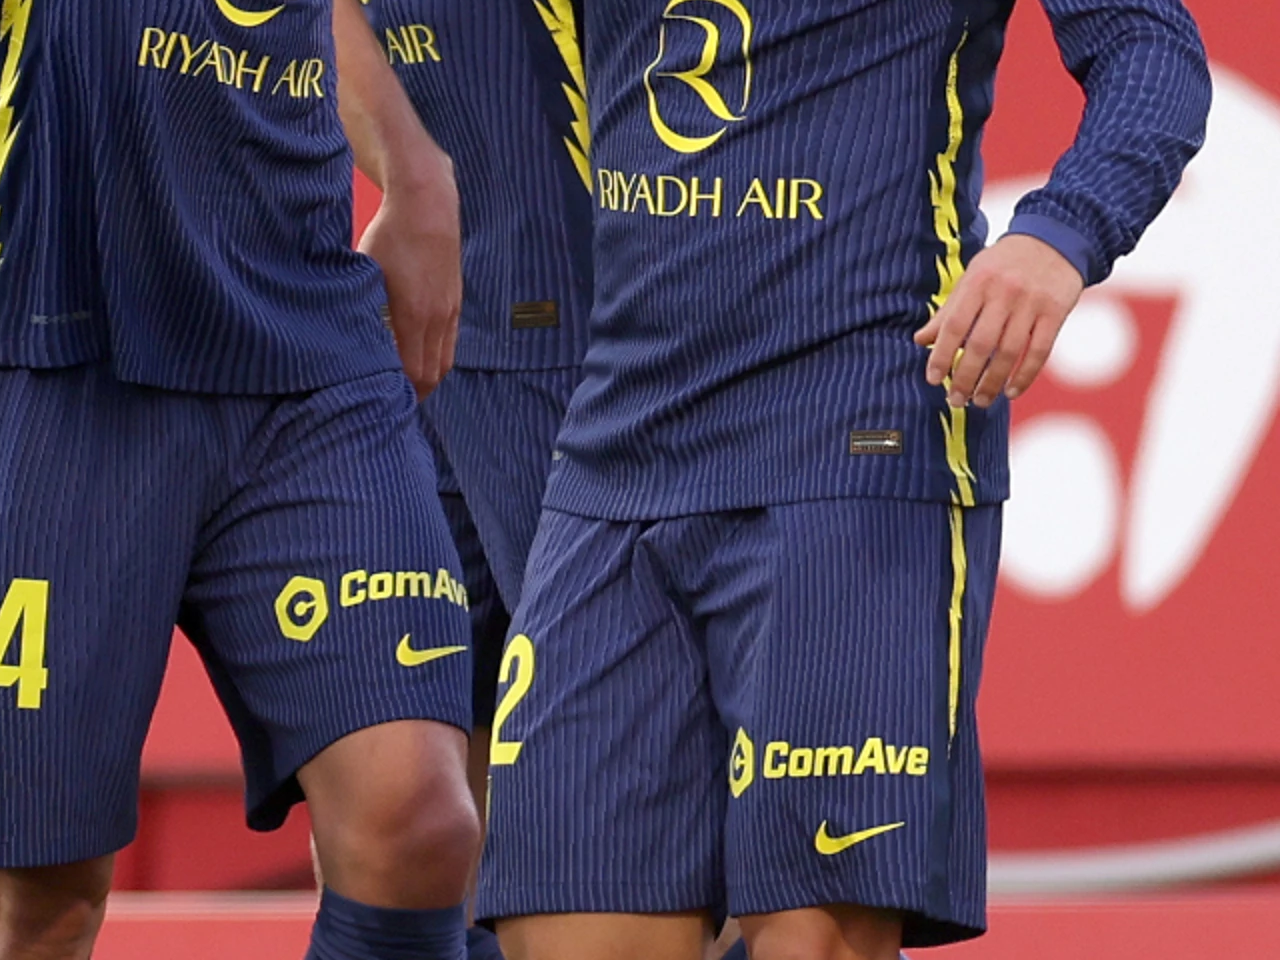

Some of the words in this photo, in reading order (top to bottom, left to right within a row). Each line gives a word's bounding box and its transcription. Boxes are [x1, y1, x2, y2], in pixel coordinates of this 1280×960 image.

[137, 26, 271, 93] RIYADH
[271, 58, 326, 99] AIR
[385, 23, 442, 66] AIR
[597, 168, 724, 219] RIYADH
[737, 177, 825, 221] AIR
[340, 567, 470, 613] ComAv
[762, 736, 930, 780] ComAve
